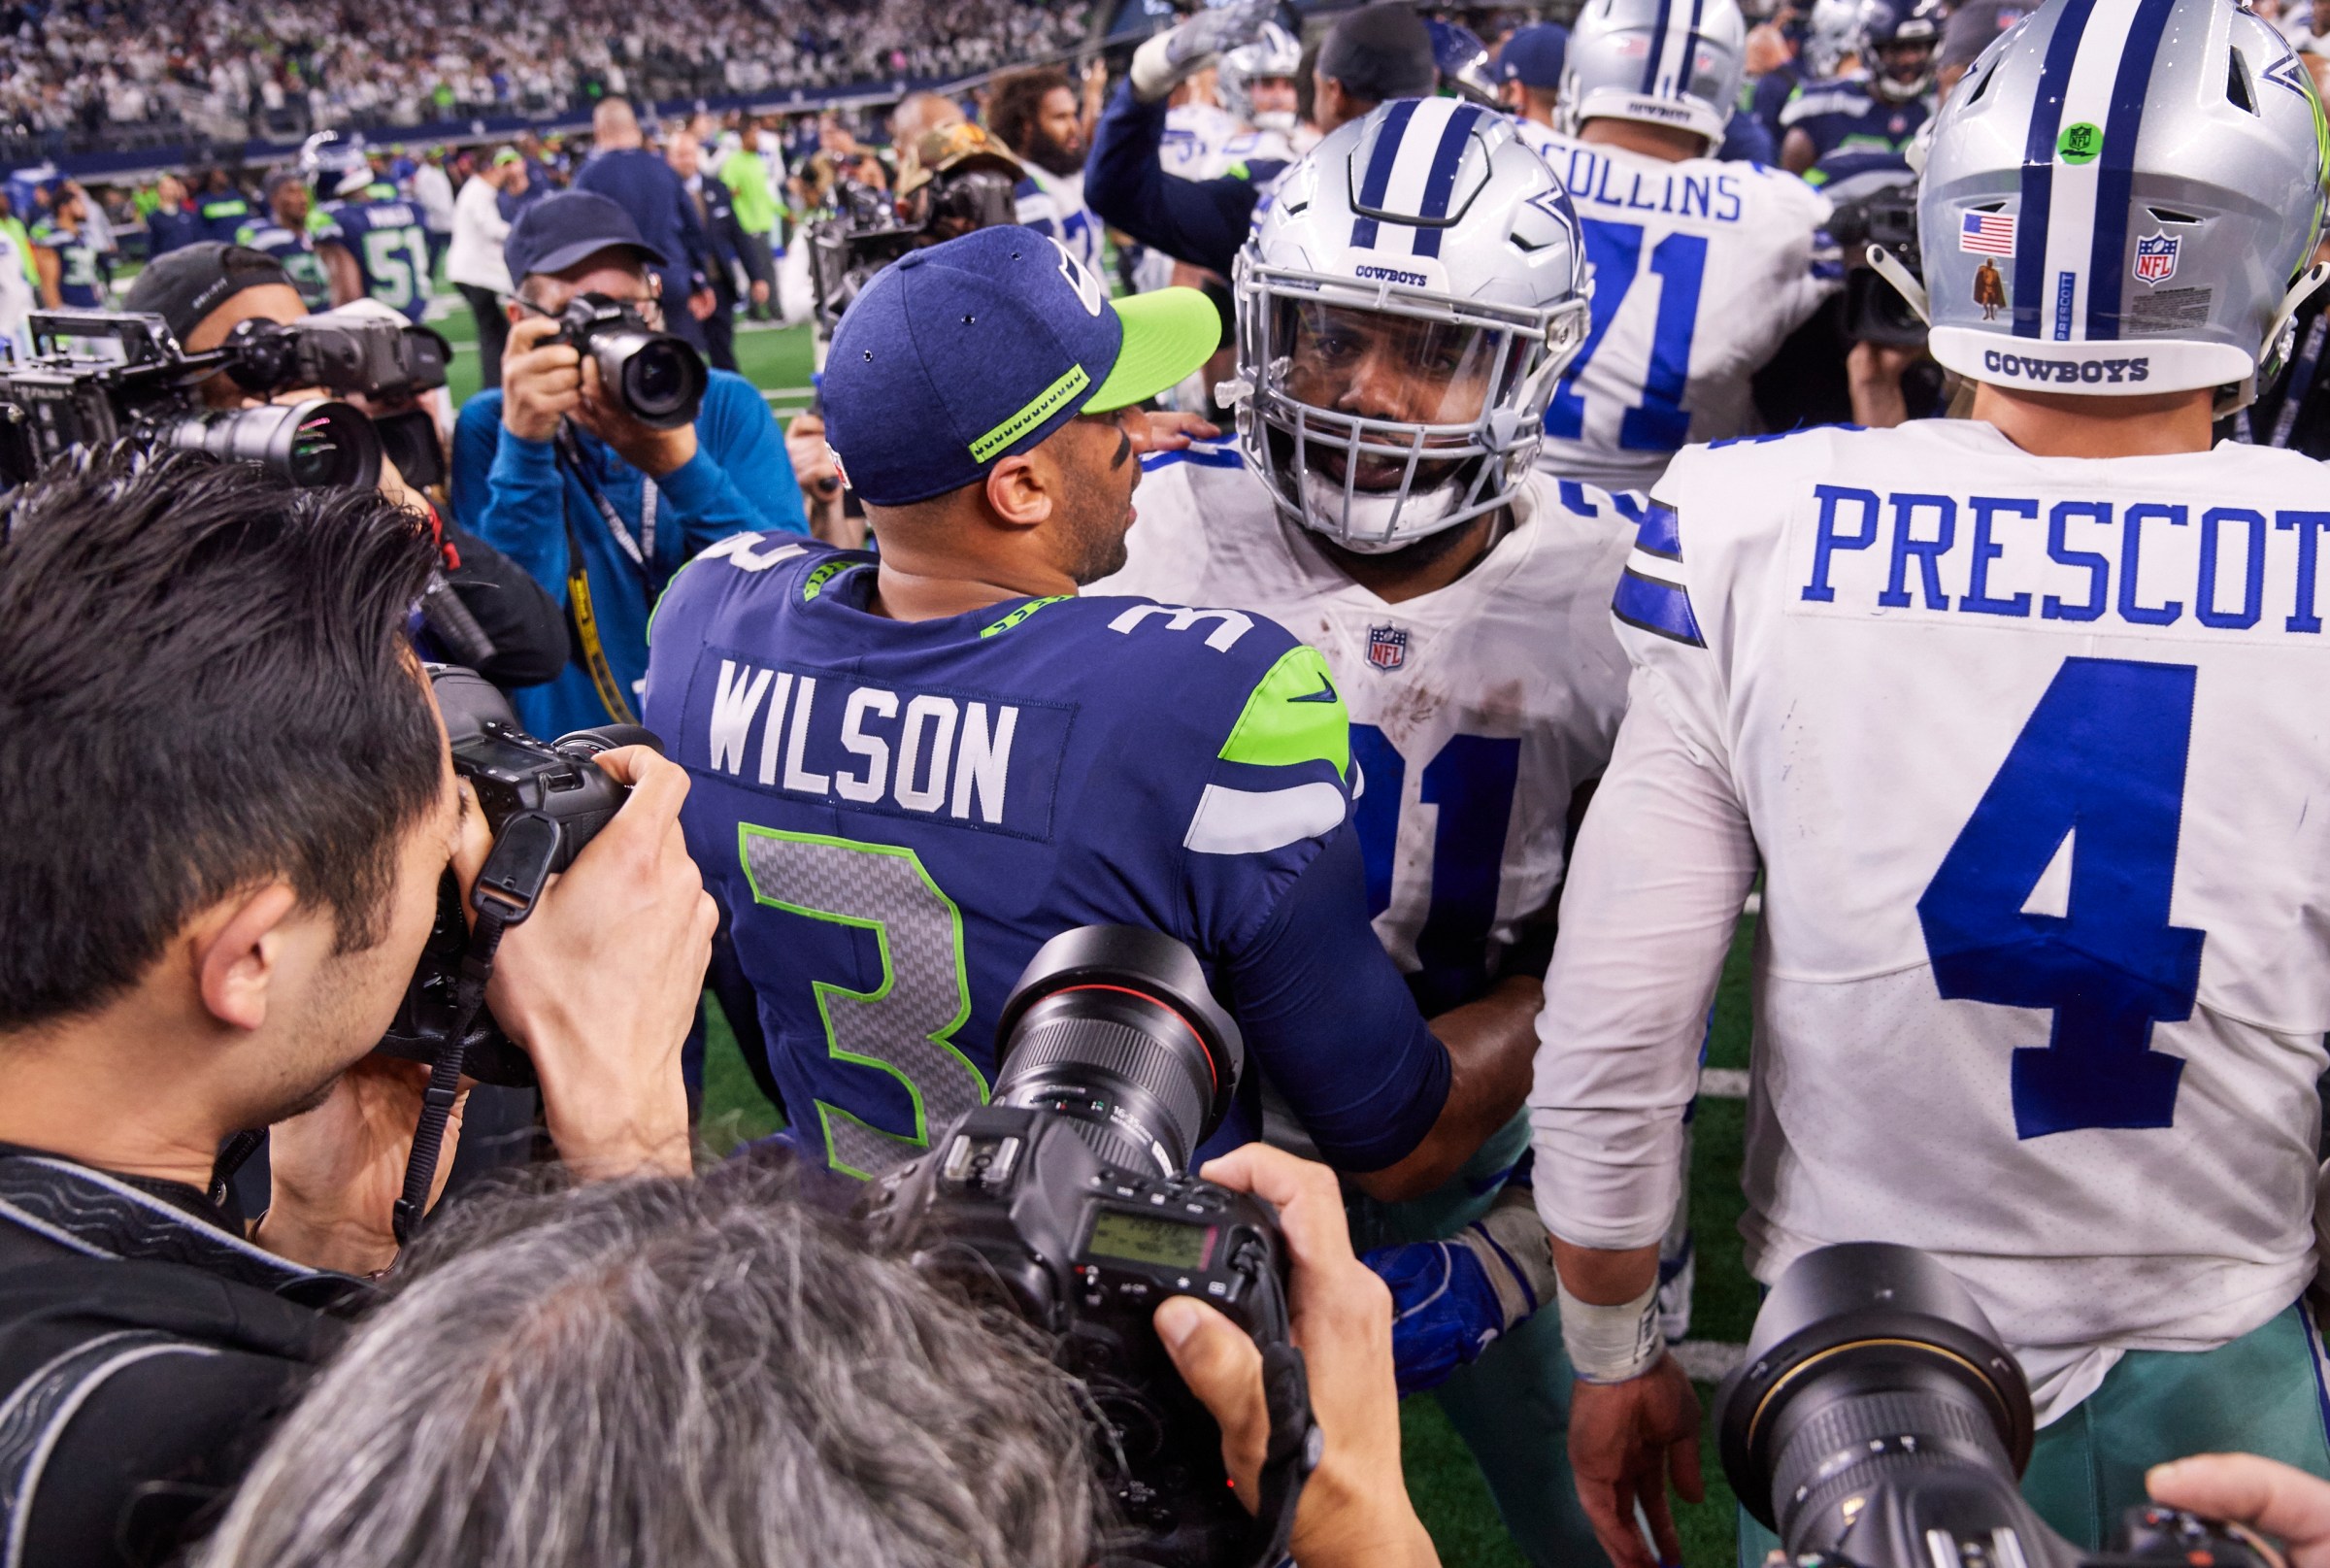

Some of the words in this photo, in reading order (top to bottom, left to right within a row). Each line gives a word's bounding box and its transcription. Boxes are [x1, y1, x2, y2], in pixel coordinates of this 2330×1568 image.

[2071, 135, 2090, 148] NFL
[362, 226, 433, 309] 51
[1356, 265, 1427, 286] COWBOYS
[2138, 255, 2171, 278] NFL
[1544, 217, 1709, 451] 71
[2056, 273, 2074, 340] PRESCOTT
[1984, 350, 2149, 383] COWBOYS
[1801, 484, 2330, 634] PRESCOT
[1372, 643, 1401, 665] NFL
[710, 658, 1019, 824] WILSON
[1916, 655, 2207, 1140] 4
[738, 821, 992, 1182] 3
